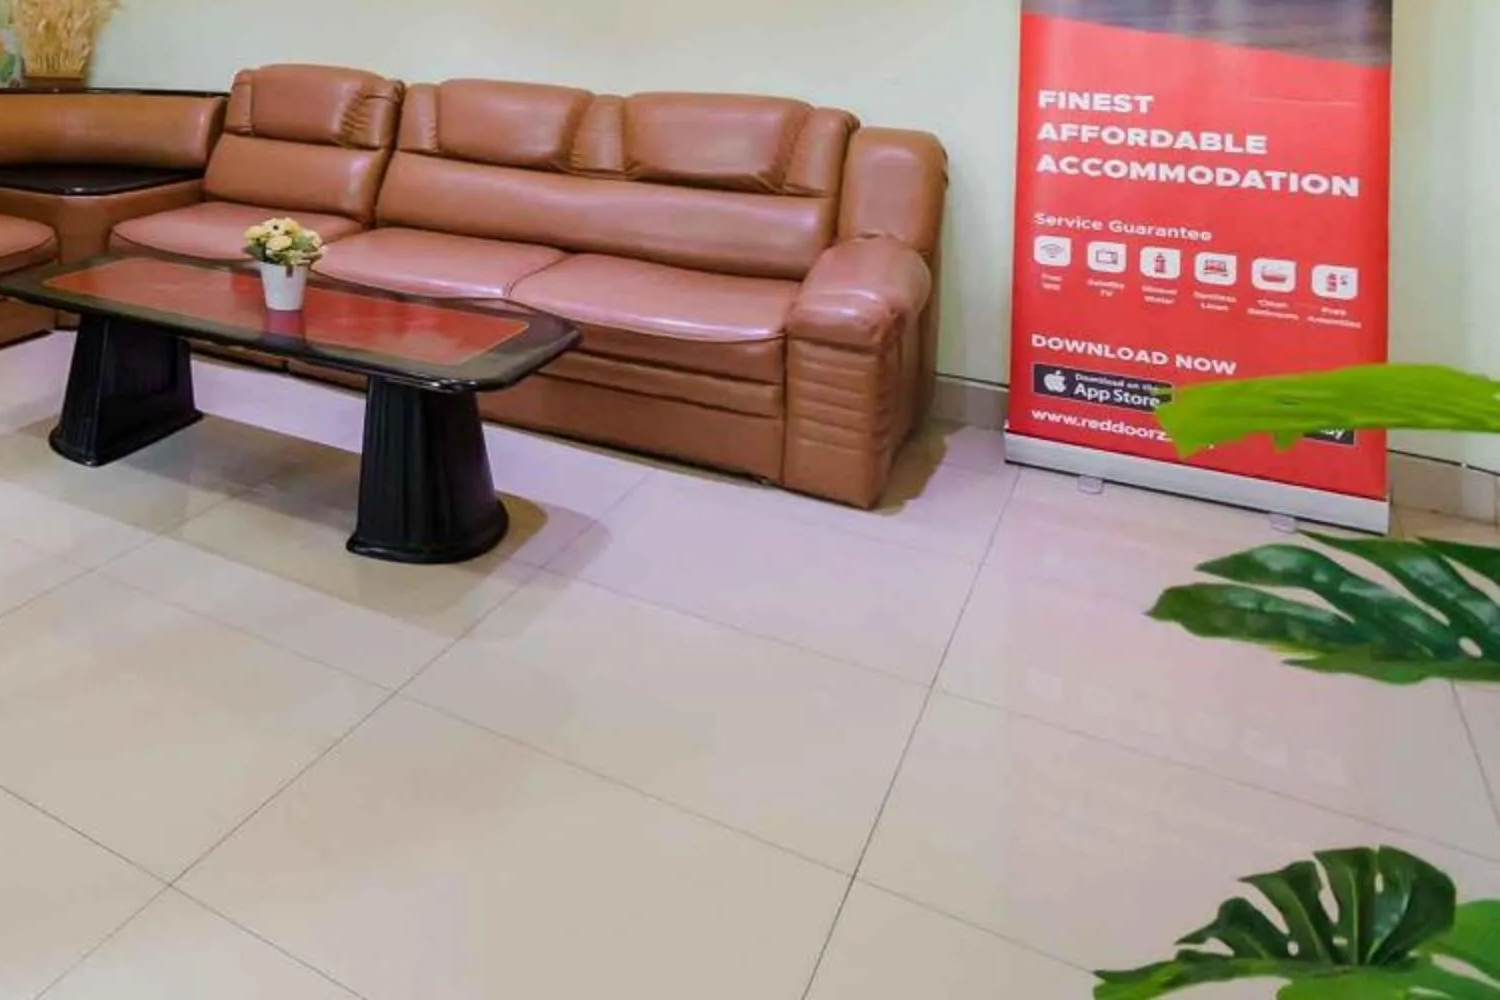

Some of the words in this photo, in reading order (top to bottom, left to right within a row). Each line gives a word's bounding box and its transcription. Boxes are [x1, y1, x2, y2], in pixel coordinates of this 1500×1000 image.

[1038, 89, 1154, 113] FINEST
[1037, 121, 1268, 155] AFFORDABLE
[1037, 154, 1360, 197] ACCOMMODATION
[1033, 212, 1103, 231] Service
[1108, 218, 1213, 241] Guarantee
[1031, 333, 1169, 366] DOWNLOAD
[1175, 353, 1238, 376] NOW
[1073, 383, 1111, 402] App
[1113, 389, 1161, 407] Store
[1075, 373, 1125, 387] Download
[1031, 410, 1174, 442] www.reddoorz.
